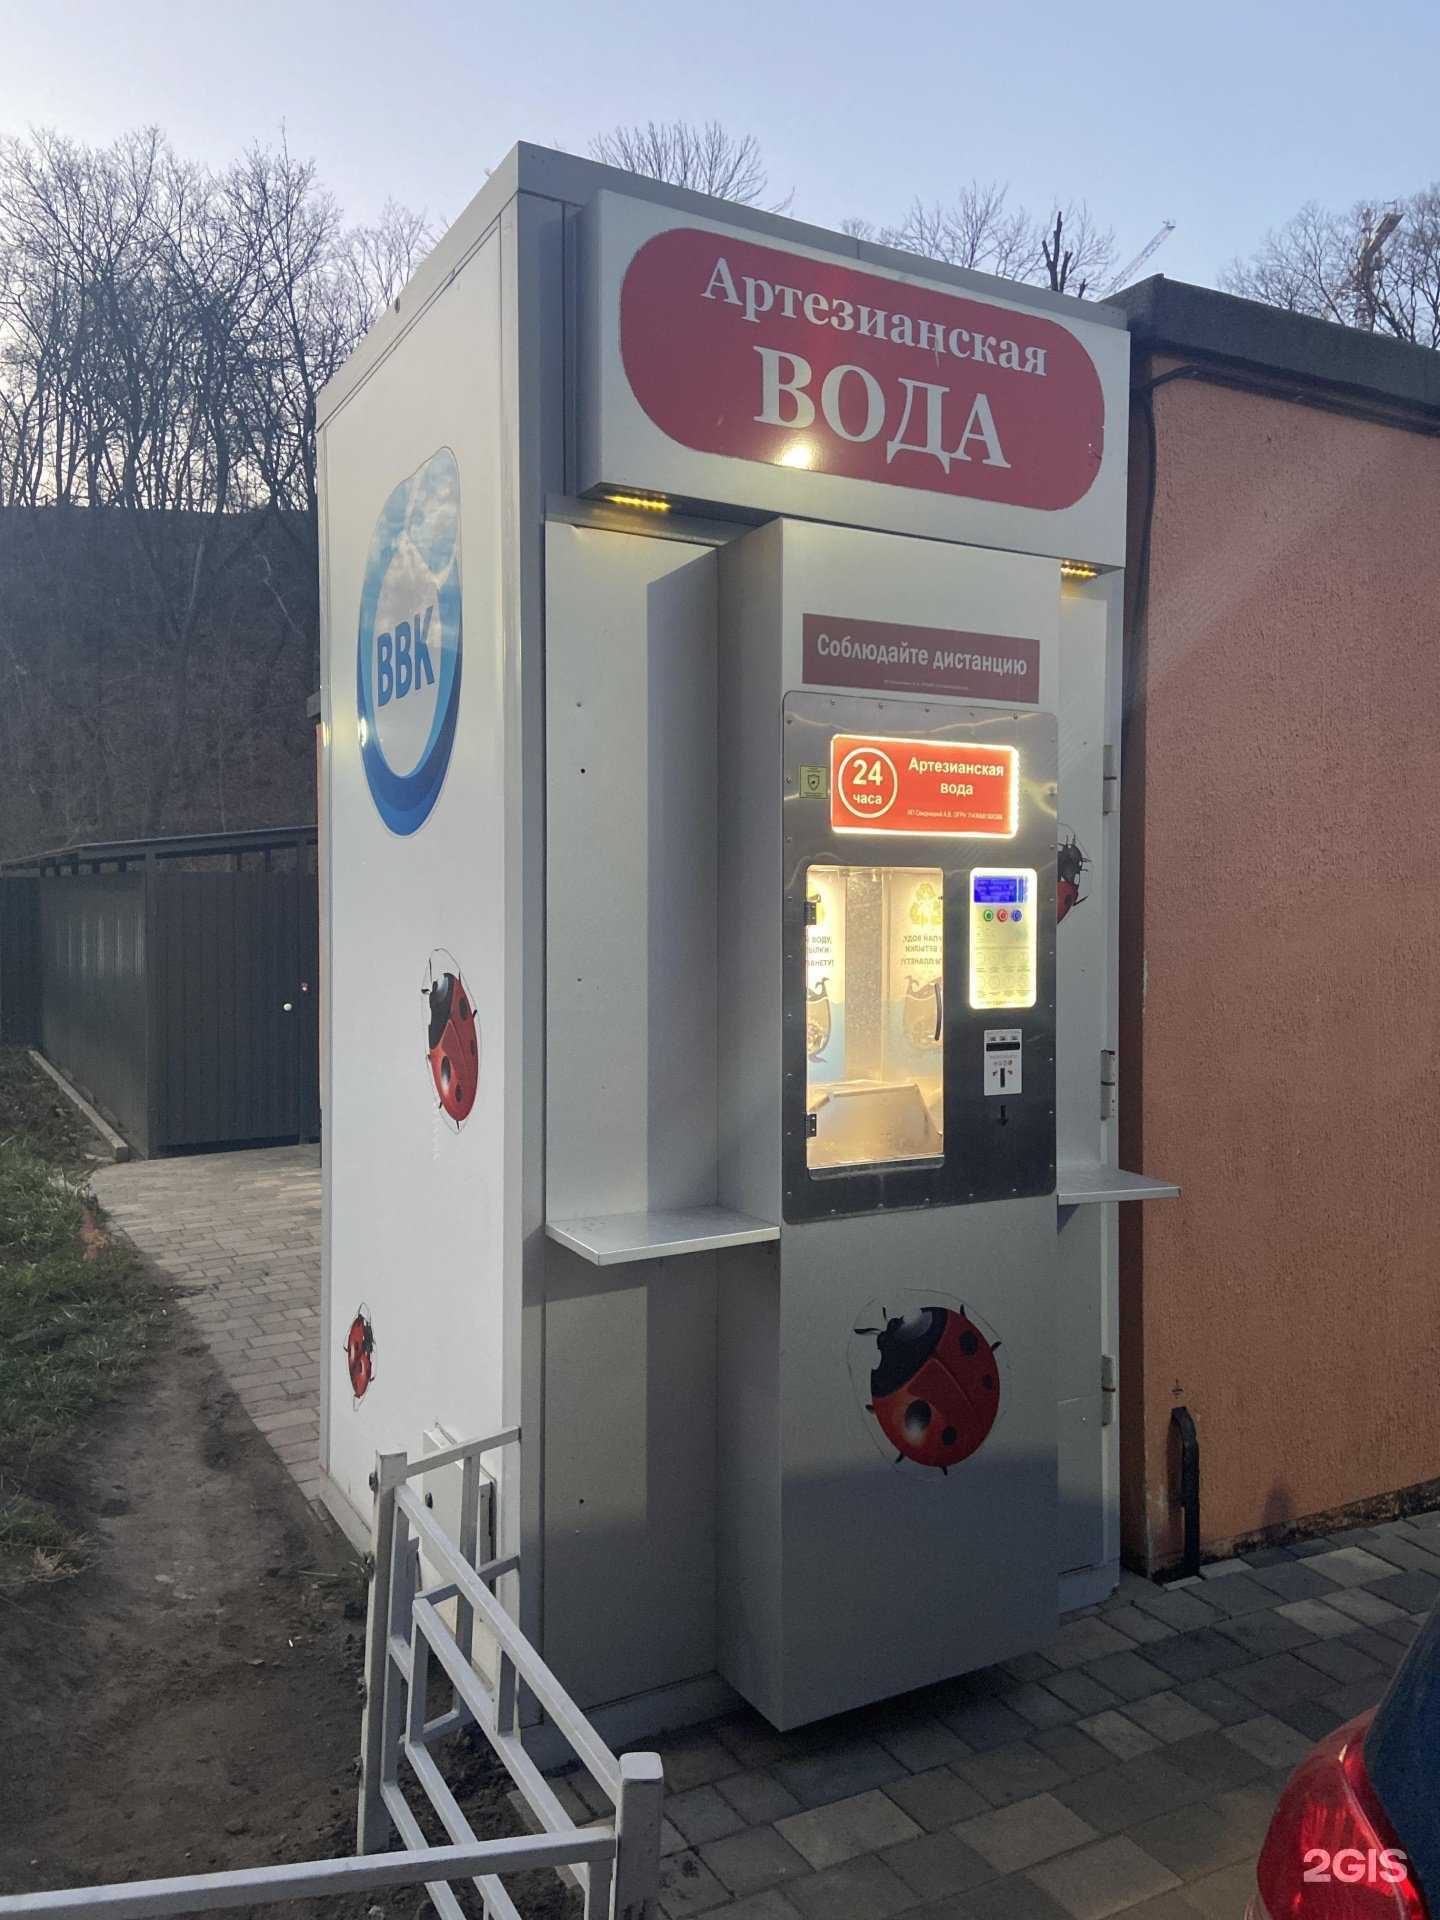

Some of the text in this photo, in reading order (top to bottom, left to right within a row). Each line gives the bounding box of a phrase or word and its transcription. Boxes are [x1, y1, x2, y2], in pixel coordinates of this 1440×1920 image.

[701, 257, 1048, 377] Артезианская
[753, 345, 1012, 474] ВОДА
[817, 633, 1028, 676] Соблюдайте дистанцию
[852, 758, 883, 786] 24
[908, 756, 1004, 777] Артезианская
[852, 792, 882, 805] часа
[940, 781, 974, 796] вода
